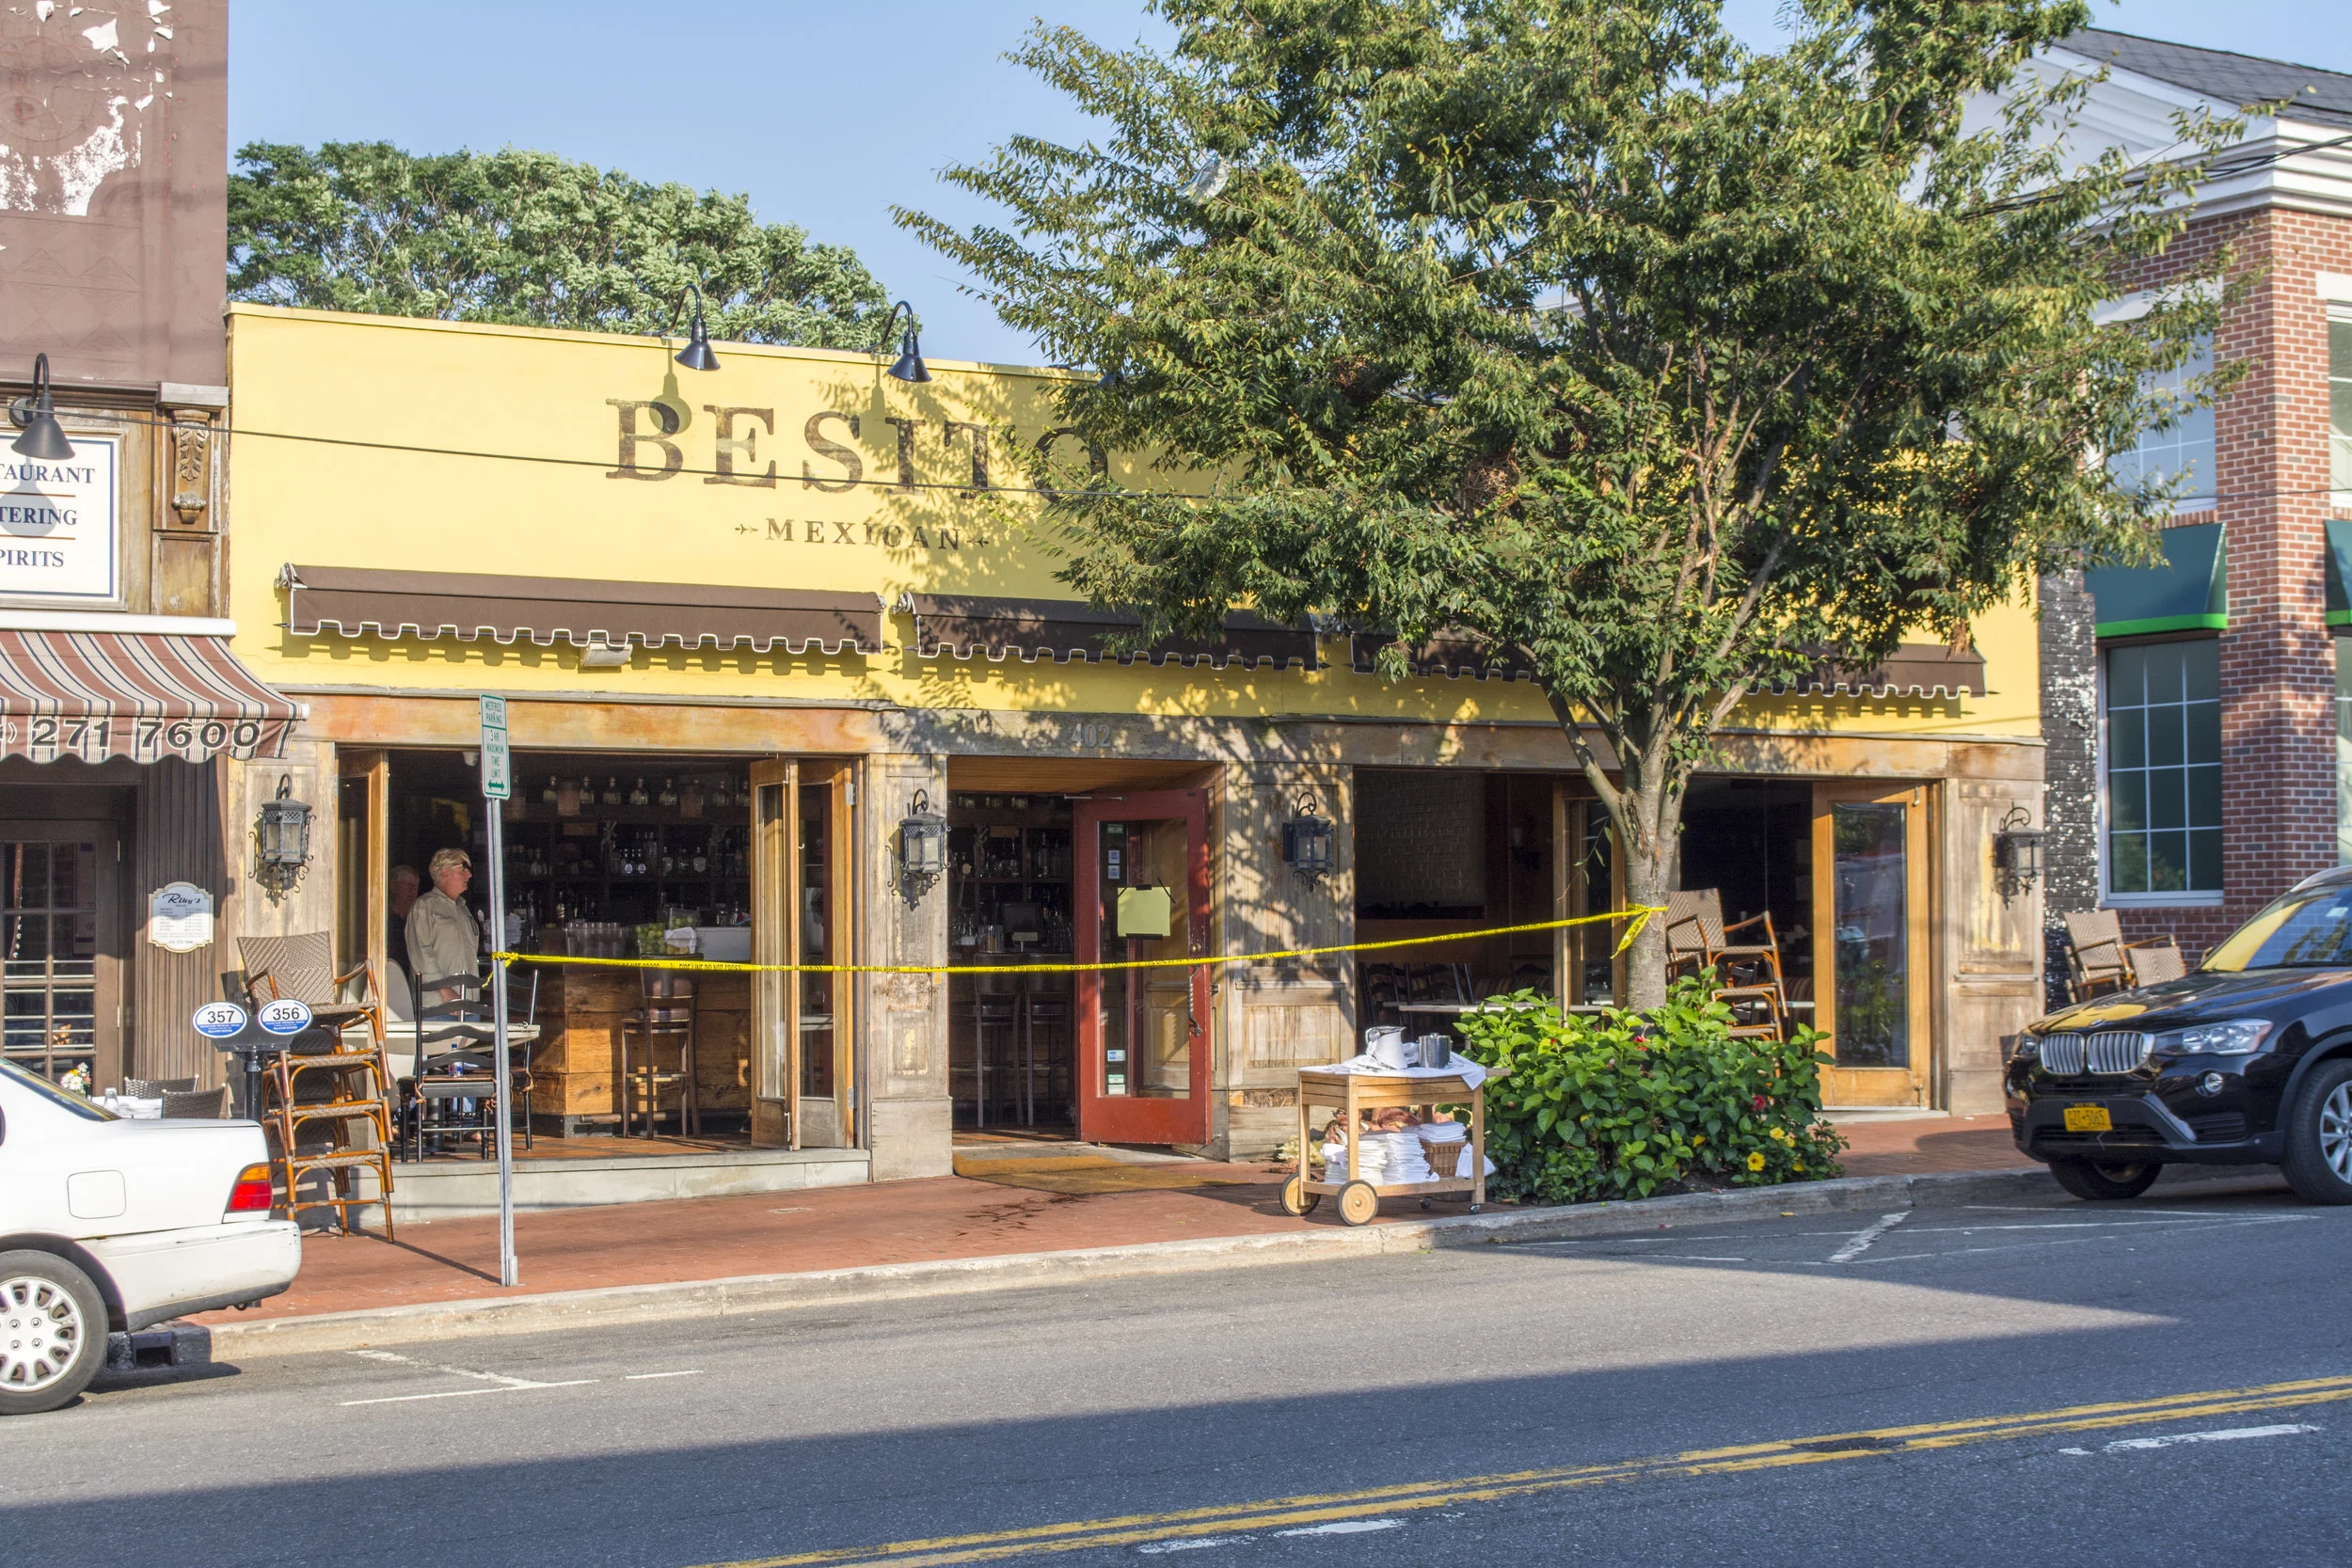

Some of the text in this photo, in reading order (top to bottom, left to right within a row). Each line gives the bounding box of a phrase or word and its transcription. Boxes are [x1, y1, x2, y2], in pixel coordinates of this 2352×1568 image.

[605, 398, 1108, 504] BESITO
[0, 506, 77, 526] TERING
[765, 517, 961, 551] MEXICAN
[1072, 723, 1111, 748] 402
[162, 893, 201, 905] Riley's
[207, 1010, 235, 1024] 357
[272, 1006, 300, 1022] 356
